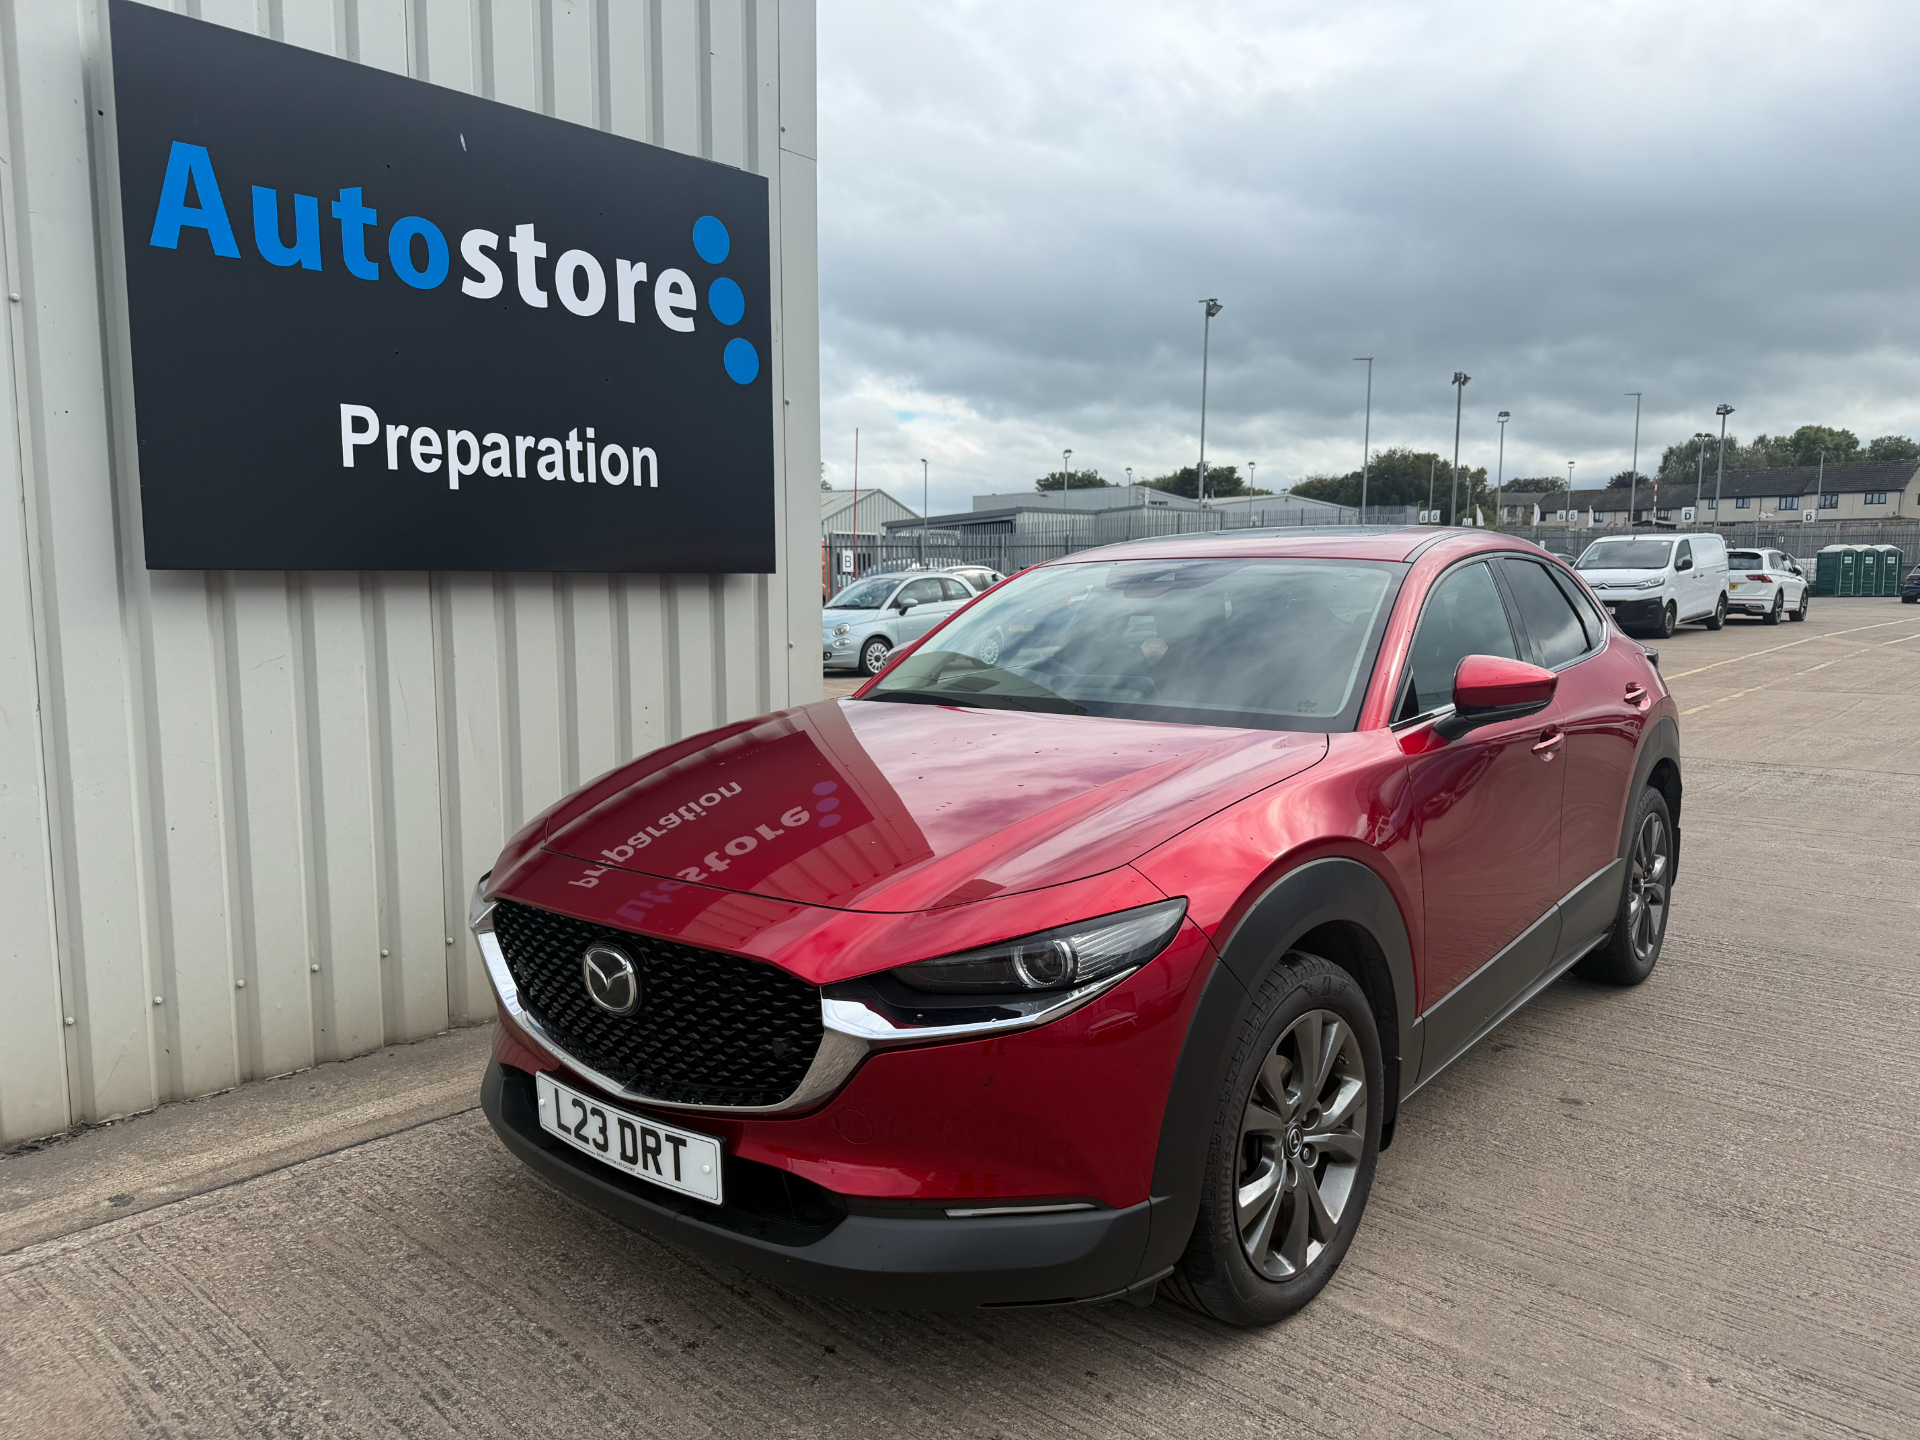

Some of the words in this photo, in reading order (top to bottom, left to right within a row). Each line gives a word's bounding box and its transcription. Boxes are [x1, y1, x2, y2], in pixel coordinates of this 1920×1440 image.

[150, 140, 697, 332] Autostore
[339, 403, 659, 490] Preparation
[1684, 512, 1692, 521] D
[1805, 513, 1812, 521] D
[845, 555, 852, 568] B
[554, 1088, 609, 1153] L23
[617, 1117, 687, 1182] DRT
